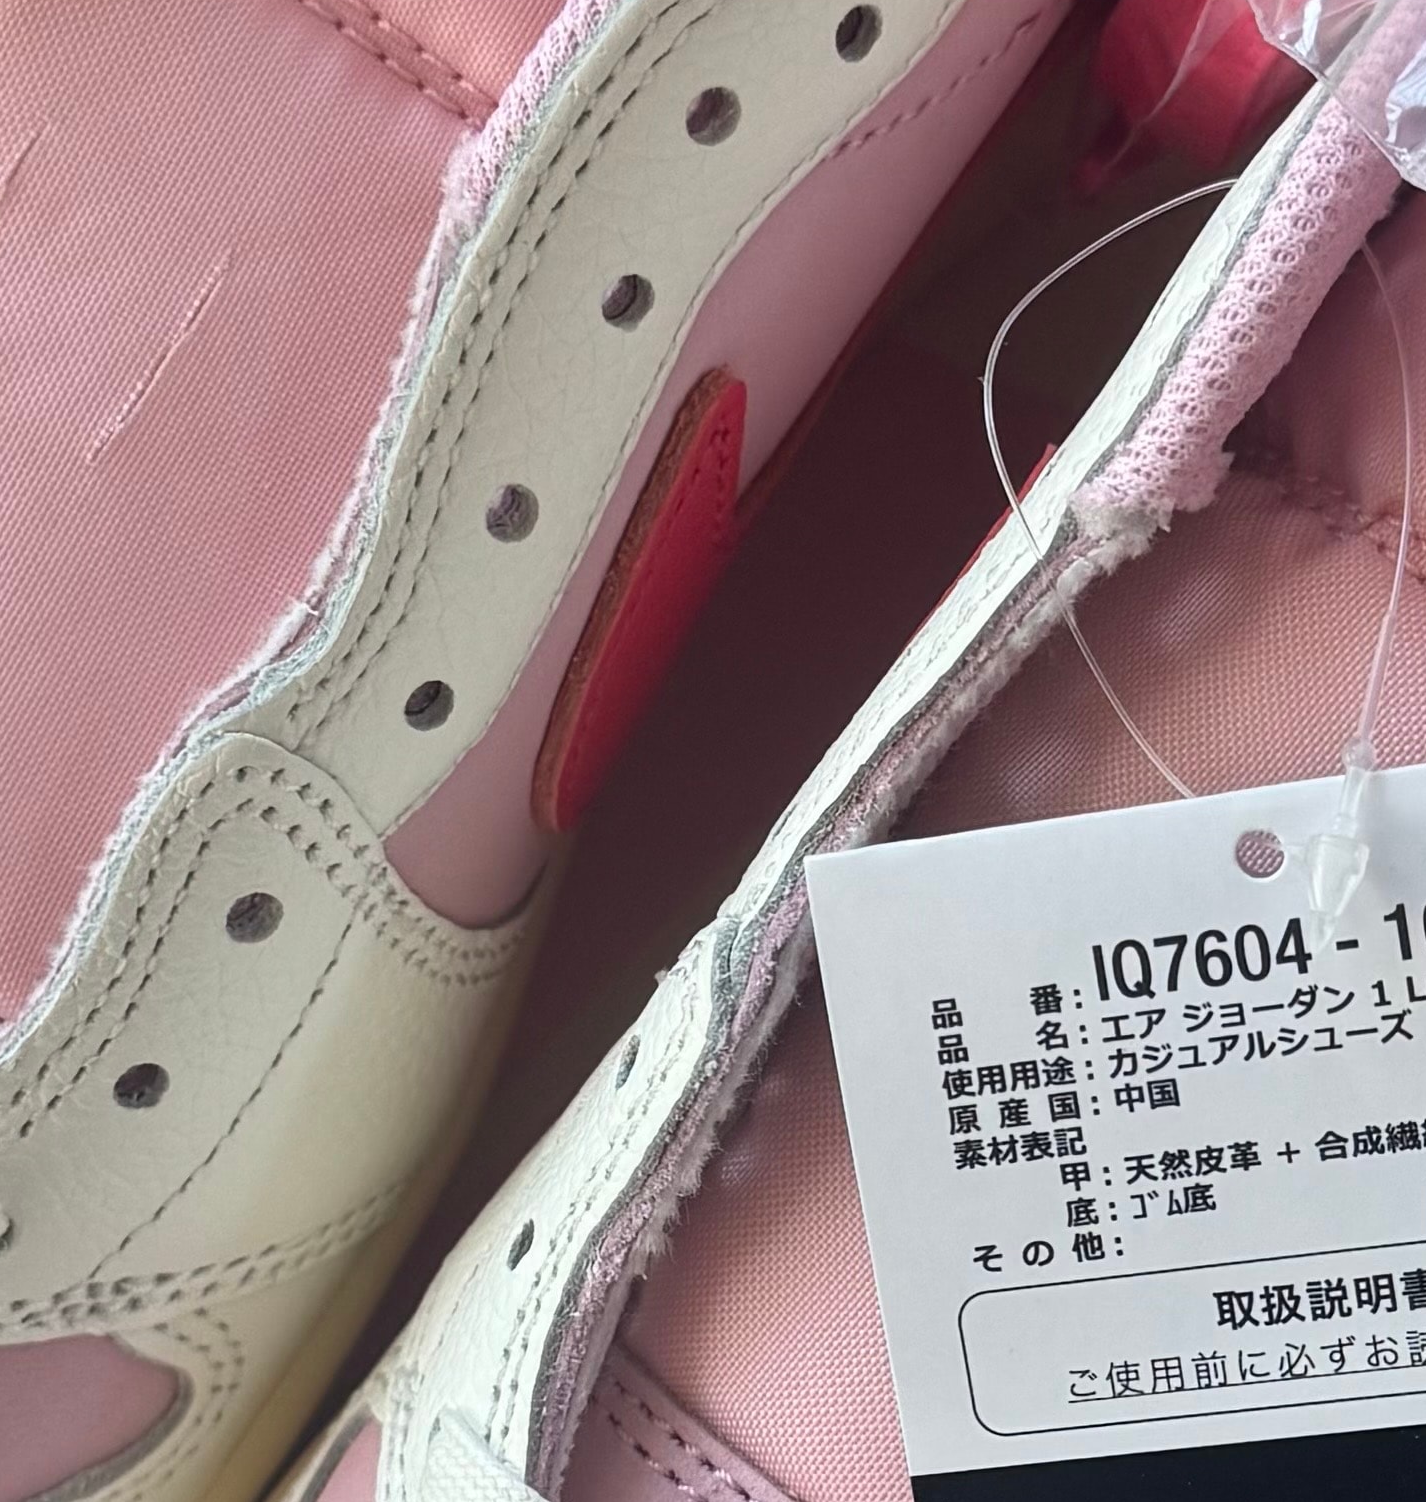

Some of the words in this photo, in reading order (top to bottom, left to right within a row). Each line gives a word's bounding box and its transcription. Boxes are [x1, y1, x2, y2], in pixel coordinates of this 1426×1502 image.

[1092, 917, 1313, 1001] IQ7604
[1101, 1008, 1166, 1044] エア
[1182, 983, 1355, 1033] ジョーダン
[1371, 980, 1392, 1007] 1
[1108, 1009, 1414, 1080] カジュアルシューズ
[1113, 1078, 1181, 1115] 中国
[953, 1126, 1087, 1170] 素材表記
[1123, 1141, 1262, 1185] 天然皮革
